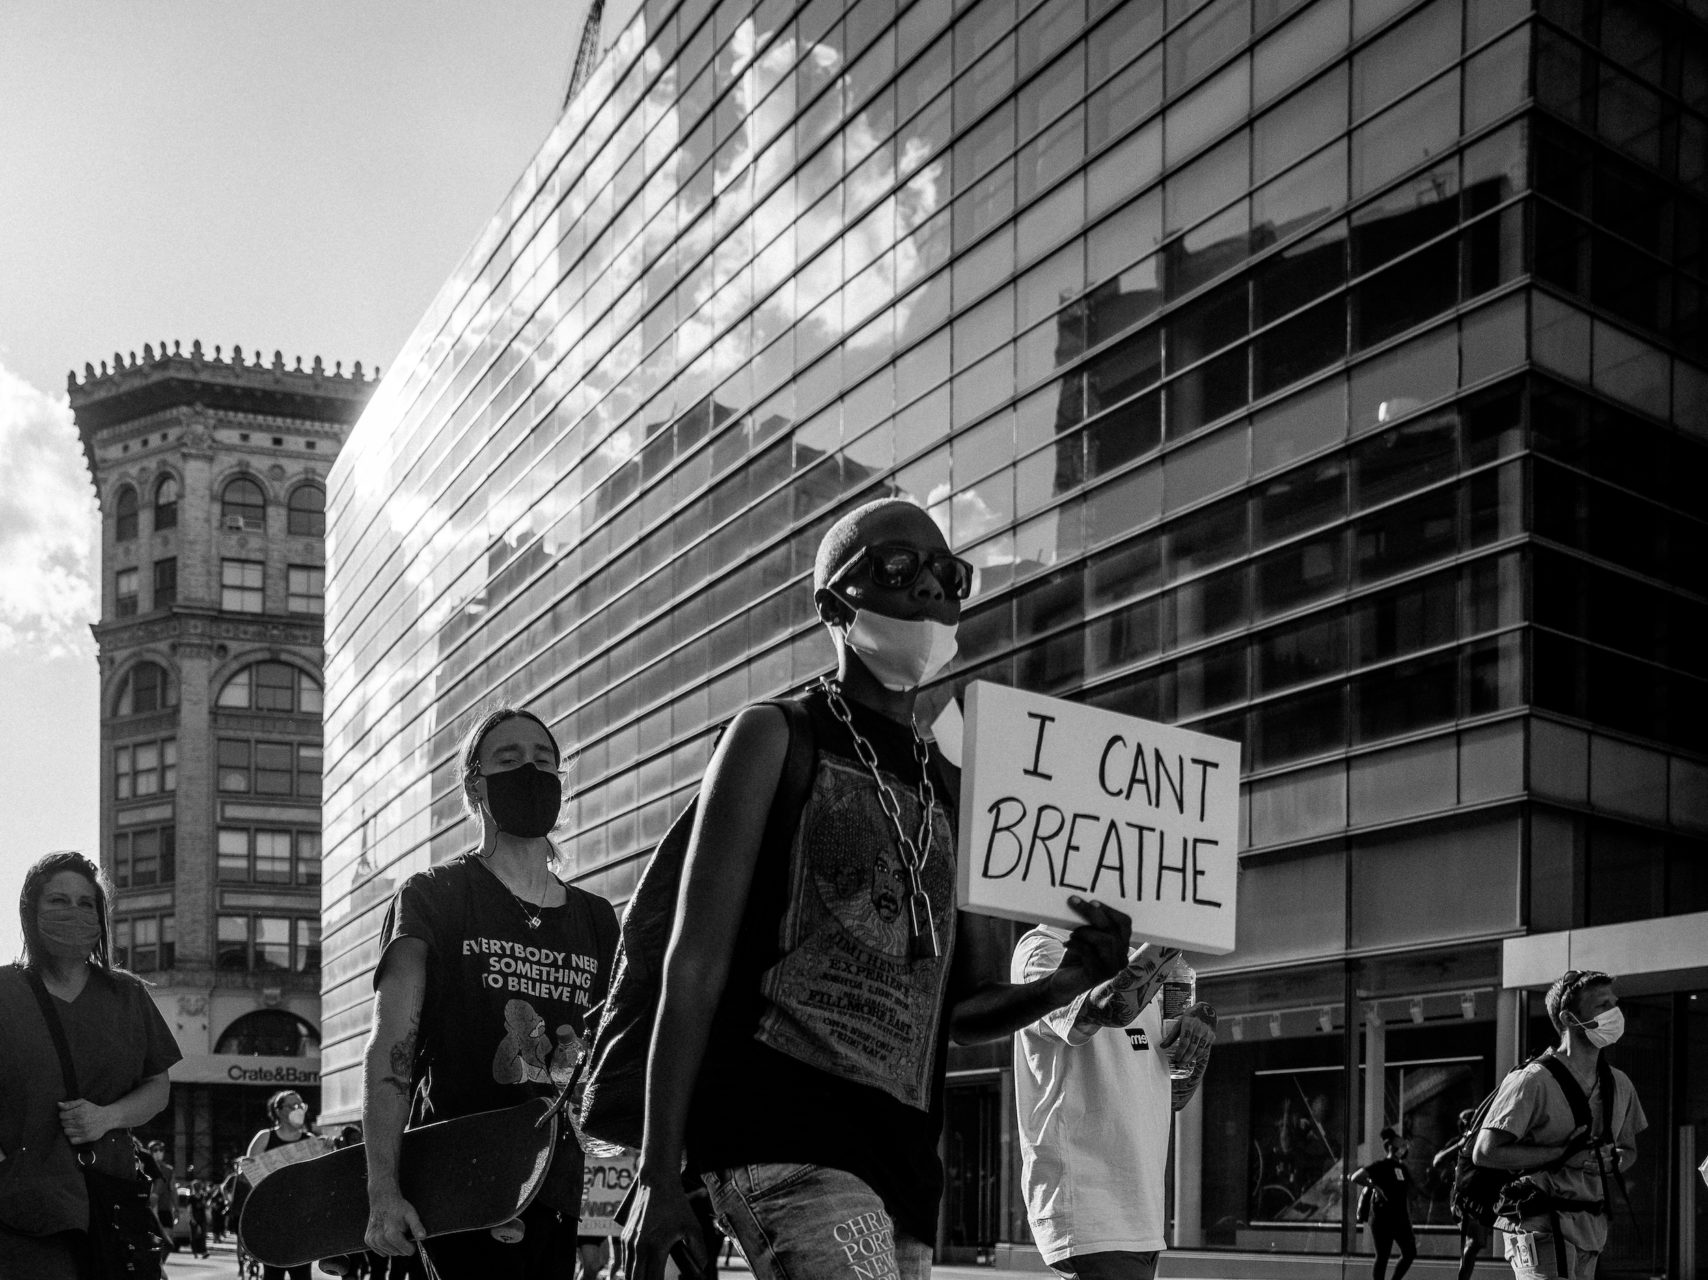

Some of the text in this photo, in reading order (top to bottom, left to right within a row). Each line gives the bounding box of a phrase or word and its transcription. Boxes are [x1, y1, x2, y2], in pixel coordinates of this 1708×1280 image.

[1023, 711, 1219, 822] I CANT
[982, 796, 1222, 908] BREATHE
[462, 937, 566, 966] EVERYBODY
[482, 973, 504, 989] TO
[507, 976, 571, 1002] BELIEVE
[489, 957, 591, 989] SOMETHING
[228, 1065, 321, 1083] Crate&Barr
[840, 1229, 895, 1265] PORT
